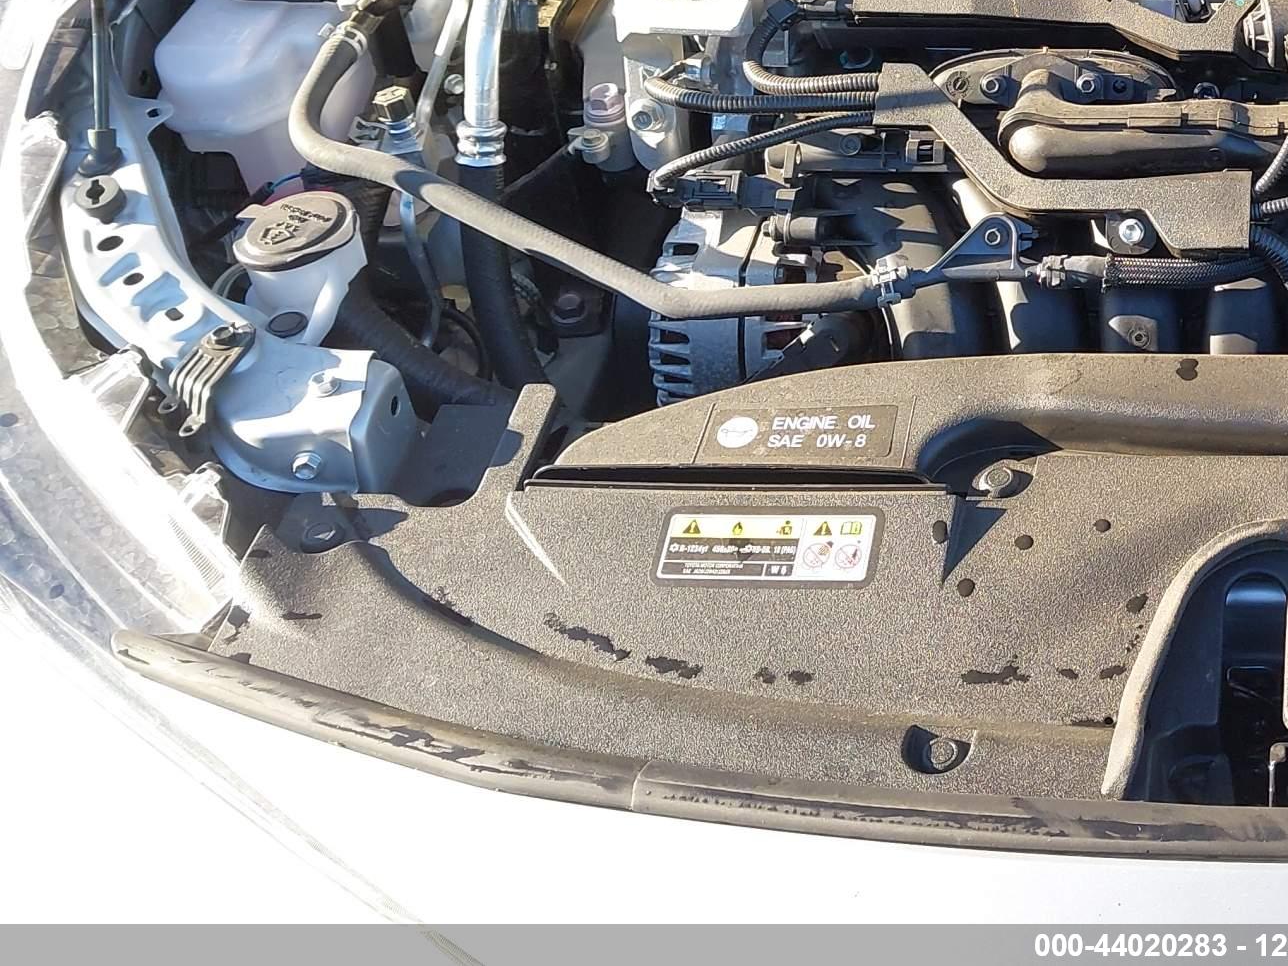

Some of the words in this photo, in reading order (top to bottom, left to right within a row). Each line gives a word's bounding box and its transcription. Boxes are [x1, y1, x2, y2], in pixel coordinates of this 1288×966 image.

[772, 416, 837, 430] ENGINE
[847, 415, 876, 429] OIL
[767, 434, 804, 448] SAE
[816, 433, 867, 448] 0W-8
